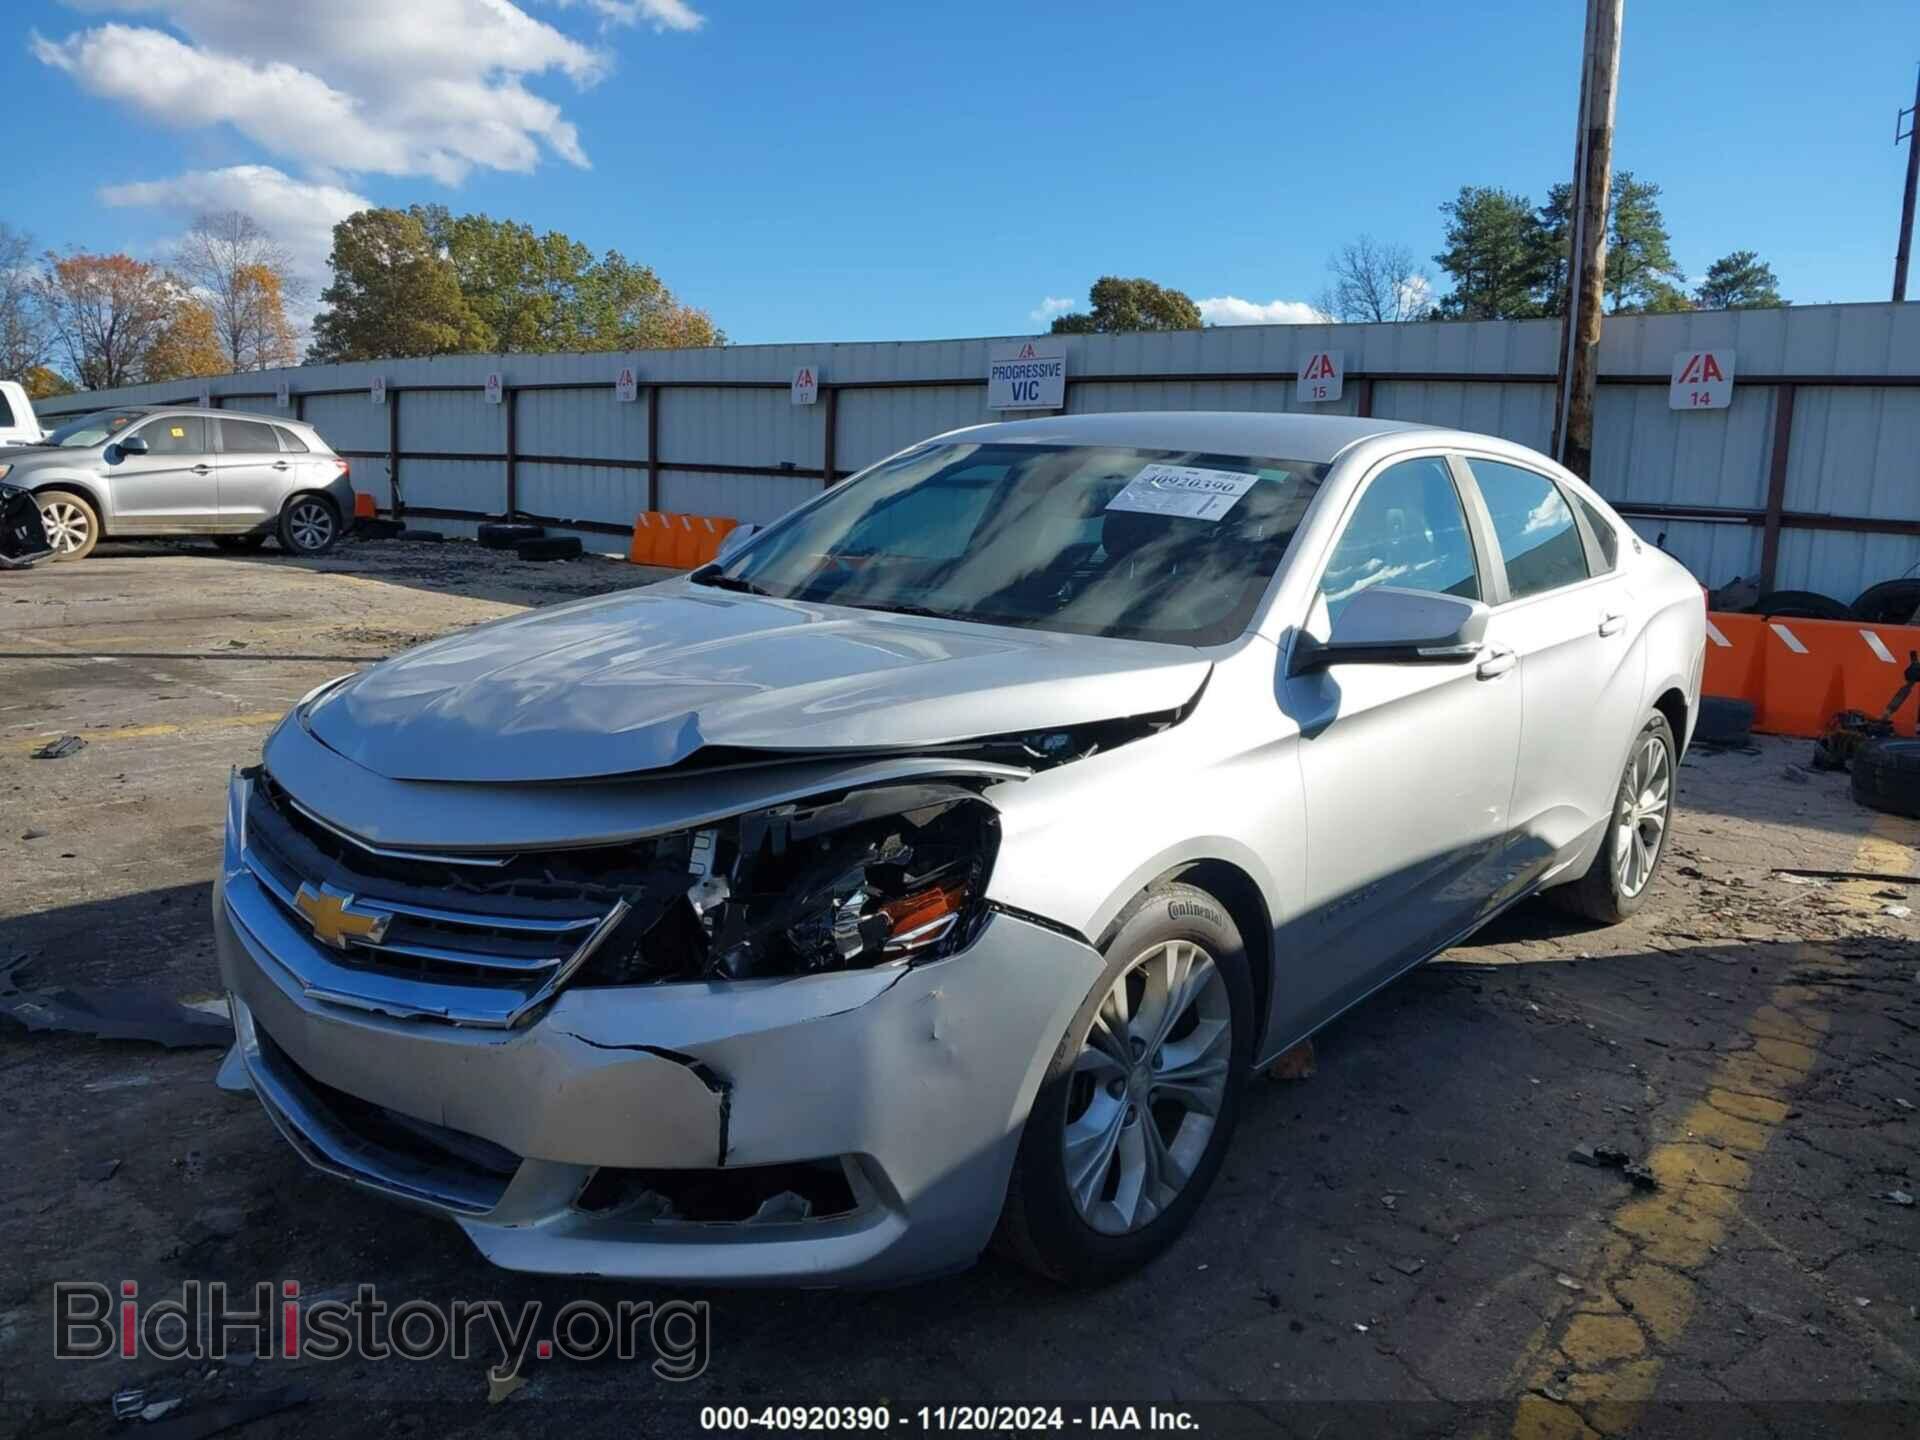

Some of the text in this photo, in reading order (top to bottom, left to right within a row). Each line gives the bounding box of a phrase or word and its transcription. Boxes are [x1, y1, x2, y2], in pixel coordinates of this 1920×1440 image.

[992, 363, 1061, 380] PROGRESSIVE
[1011, 381, 1040, 400] VIC
[1312, 386, 1327, 398] 15
[1690, 391, 1711, 406] 14
[1168, 900, 1224, 927] Continental
